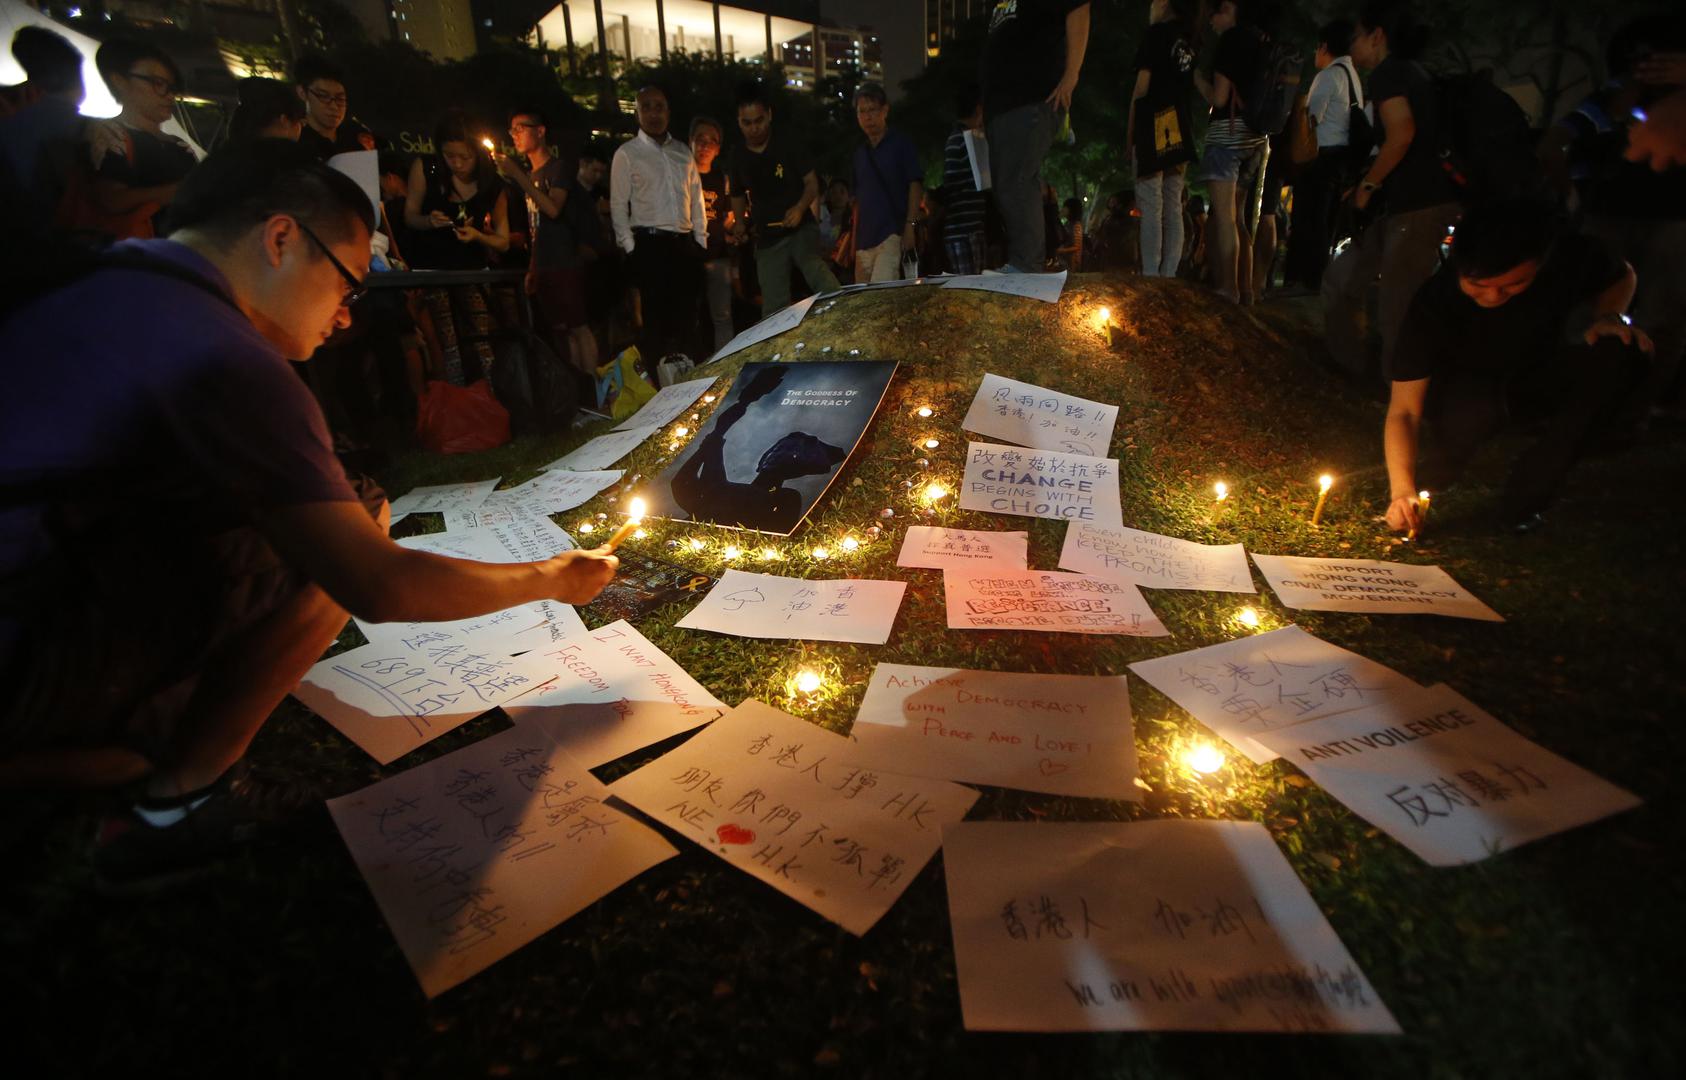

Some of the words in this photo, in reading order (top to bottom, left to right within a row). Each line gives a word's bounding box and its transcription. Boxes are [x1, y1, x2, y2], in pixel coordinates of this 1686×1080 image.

[981, 469, 1093, 492] CHANGE
[971, 482, 1036, 498] BEGINS
[1046, 491, 1093, 505] WITH
[991, 498, 1096, 521] CHOICE
[1303, 572, 1357, 584] HONG
[1362, 576, 1419, 589] KONG
[1314, 564, 1394, 576] SUPPORT
[1321, 592, 1435, 605] MOVEMENT
[1333, 584, 1458, 600] DEMOCRACY
[592, 629, 627, 643] I
[619, 644, 656, 668] WANT
[543, 644, 610, 694] FREEDOM
[955, 689, 1090, 714] DEMOCRACY
[1299, 738, 1362, 762] ANTI
[1357, 708, 1477, 751] VOILENCE
[1386, 763, 1549, 828] 反对暴力
[999, 896, 1108, 941] 香港人
